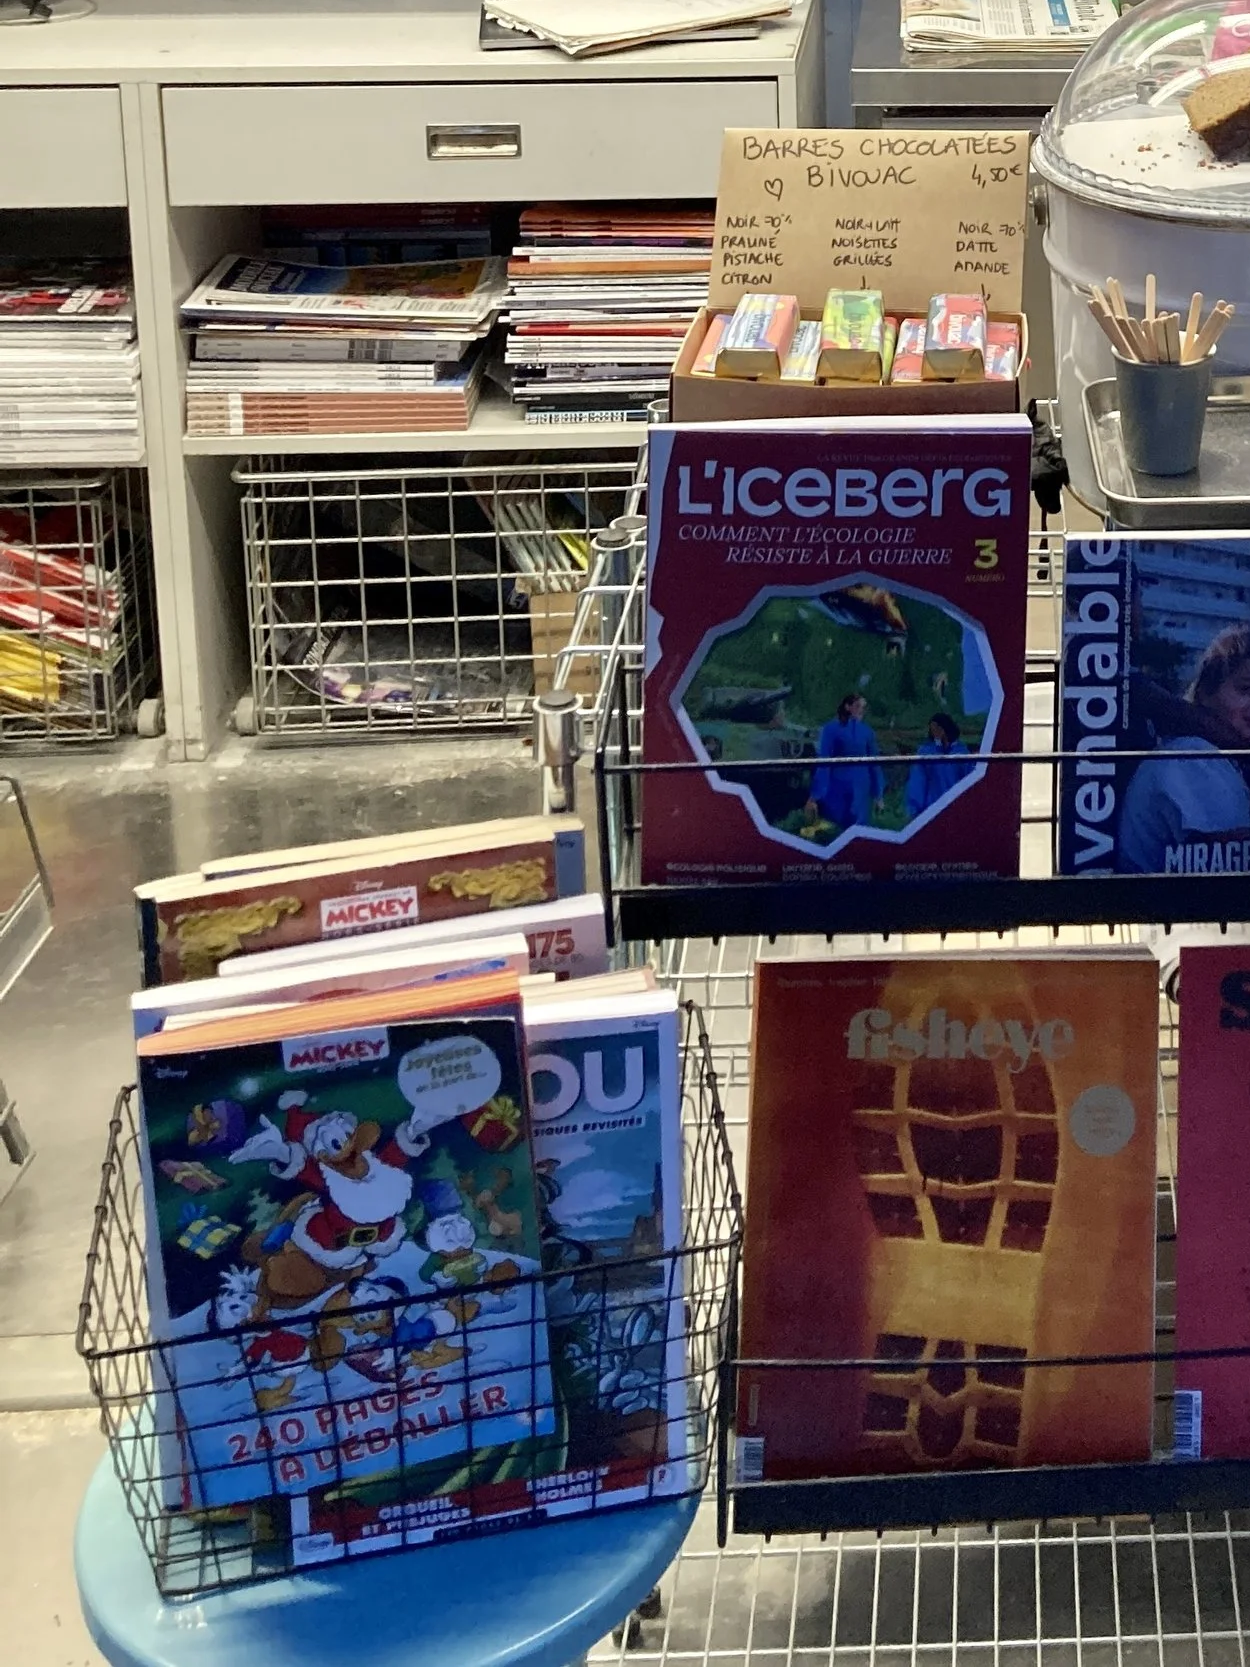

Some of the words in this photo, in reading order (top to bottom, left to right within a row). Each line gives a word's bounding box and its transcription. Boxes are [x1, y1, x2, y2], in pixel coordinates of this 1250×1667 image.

[743, 135, 845, 161] BARRES
[859, 132, 1018, 158] CHOCOLATÉES
[678, 523, 795, 544] COMMENT
[794, 522, 916, 545] L'ÉCOLOGIE
[725, 544, 813, 565] RÉSISTE
[815, 543, 832, 565] À
[834, 548, 862, 565] LA
[868, 547, 953, 565] GUERRE
[973, 538, 999, 570] 3
[1065, 540, 1122, 874] vendable
[325, 897, 414, 927] MICKEY
[288, 1037, 388, 1070] MICKEY
[843, 1006, 1077, 1074] fisheye
[227, 1418, 306, 1464] 240
[314, 1370, 444, 1433] PAGES
